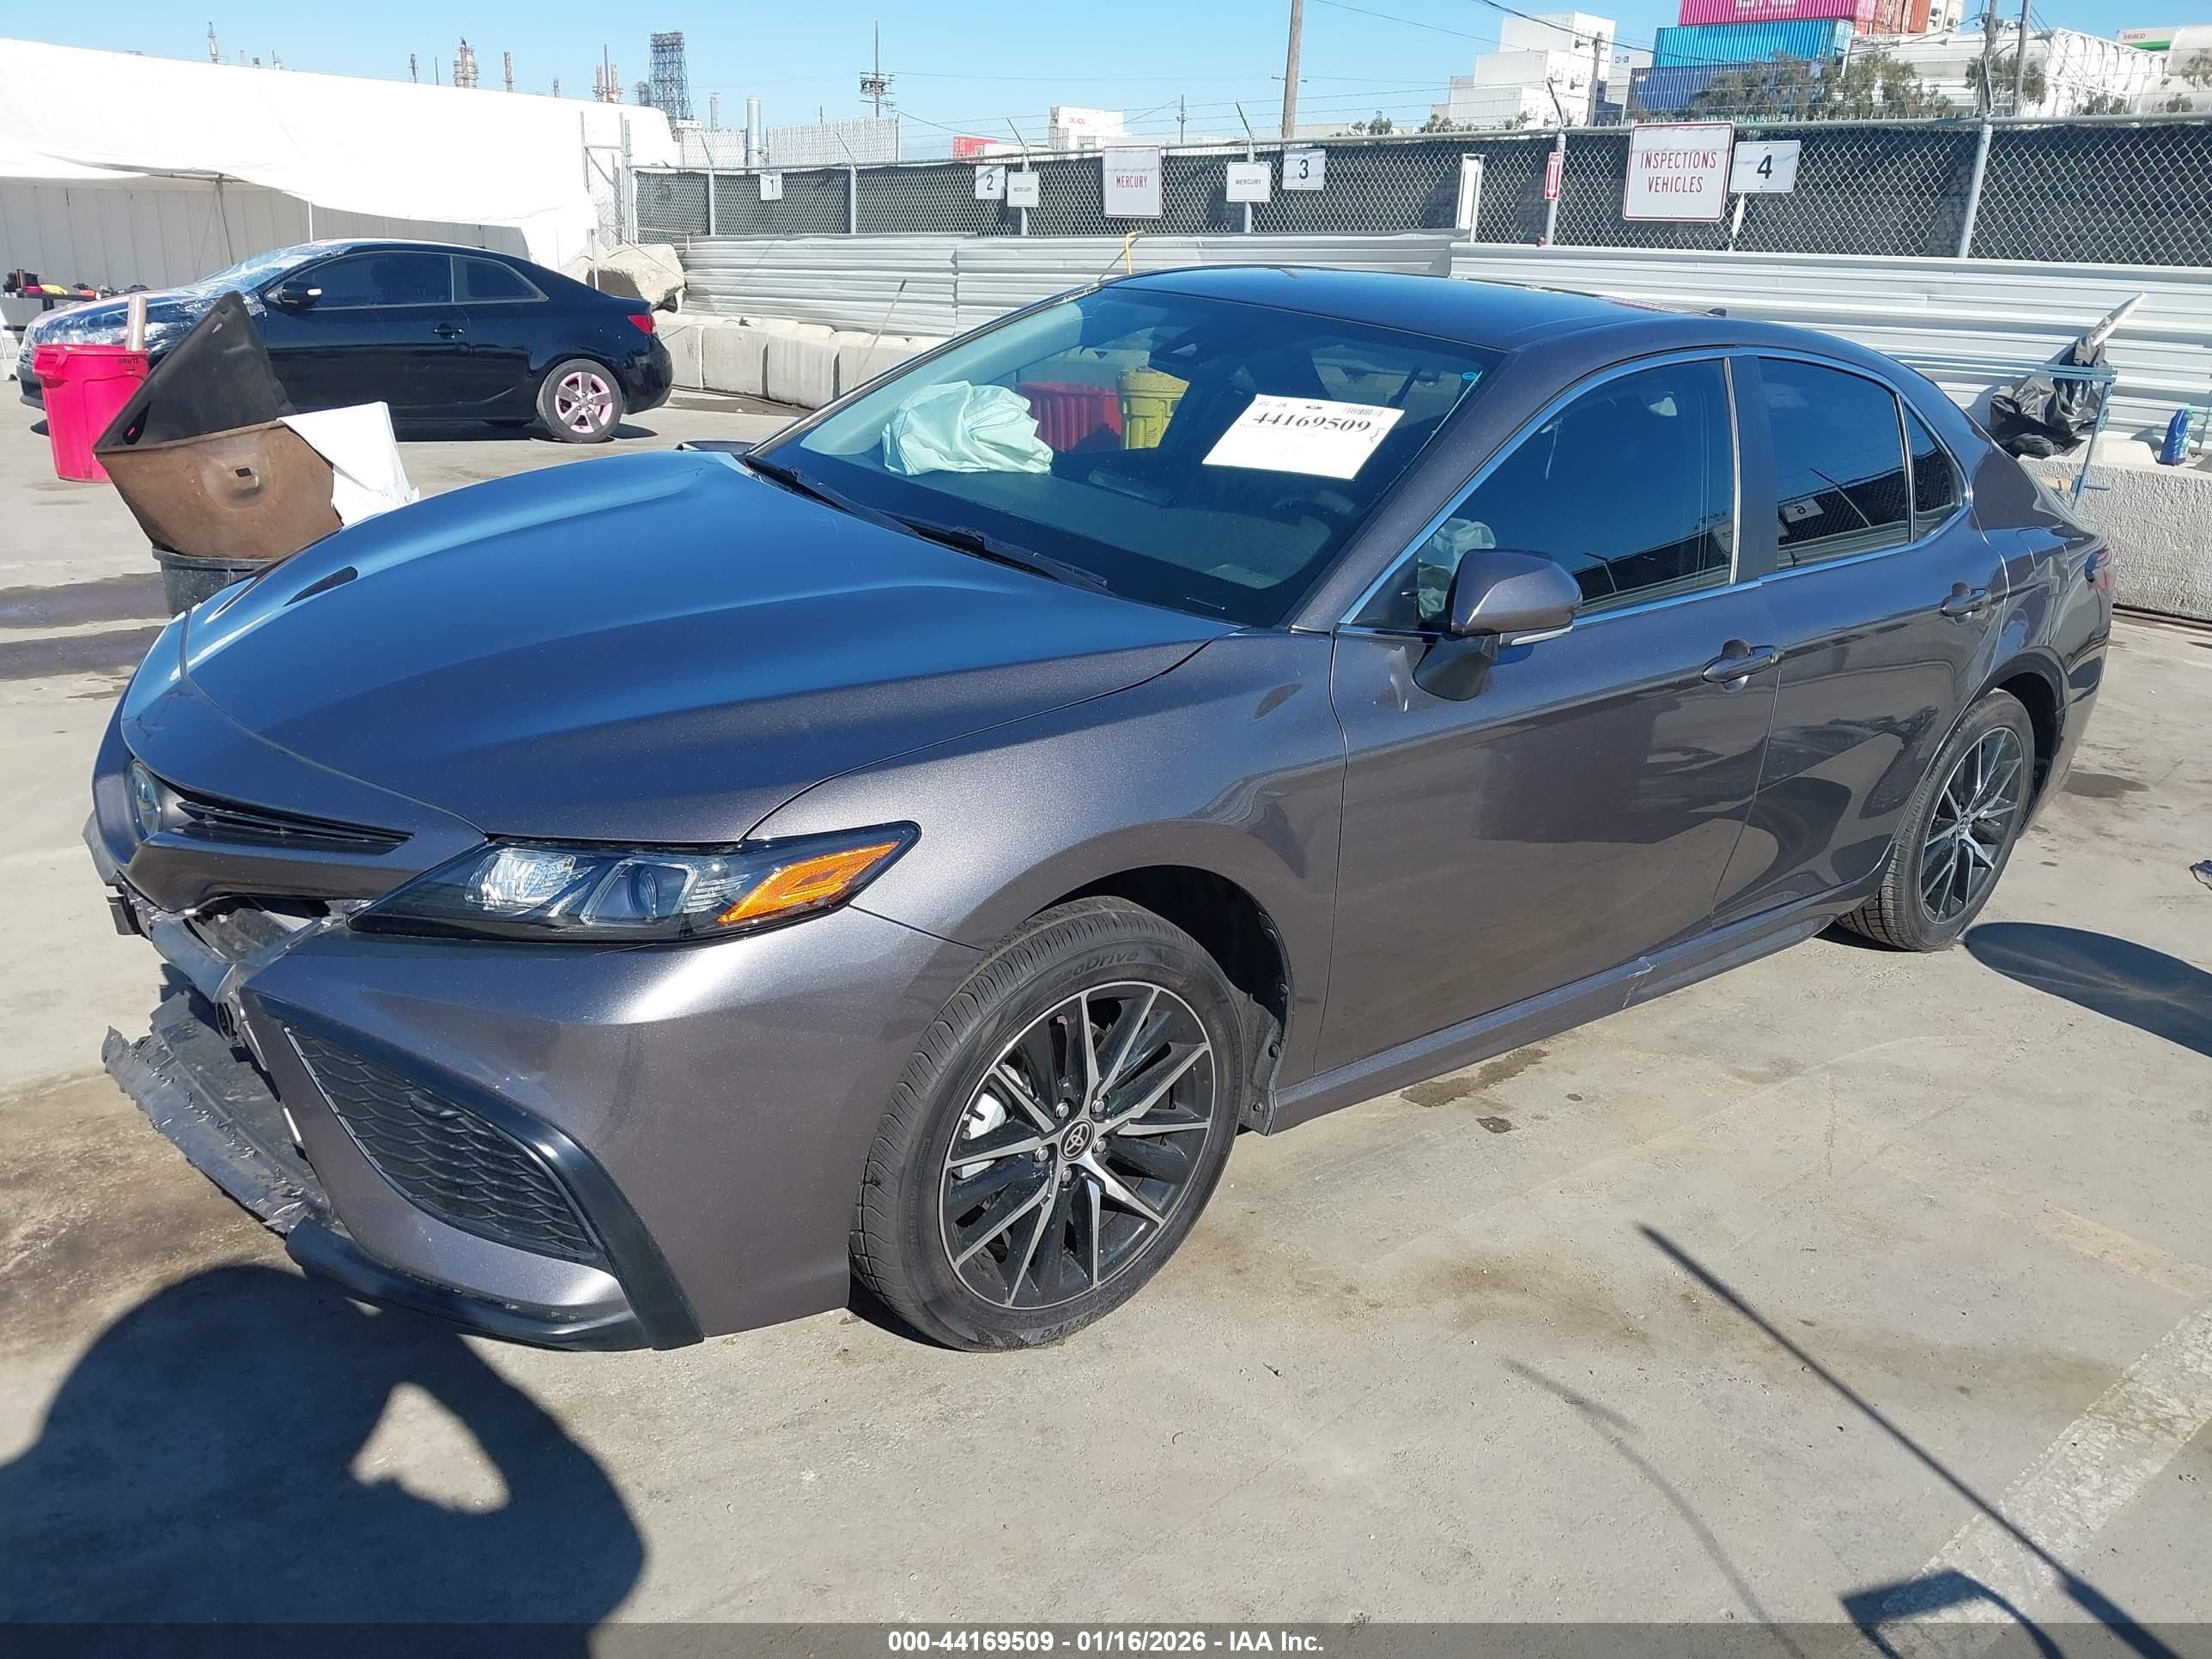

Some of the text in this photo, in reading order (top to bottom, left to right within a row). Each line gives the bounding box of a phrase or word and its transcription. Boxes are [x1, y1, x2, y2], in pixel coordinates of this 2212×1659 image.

[1640, 151, 1717, 169] INSPECTIONS
[1757, 155, 1773, 179] 4
[1299, 159, 1310, 179] 3
[769, 178, 775, 193] 1
[986, 174, 994, 191] 2
[1115, 175, 1148, 188] MERCURY
[1648, 176, 1704, 193] VEHICLES
[1253, 412, 1371, 433] 44169509
